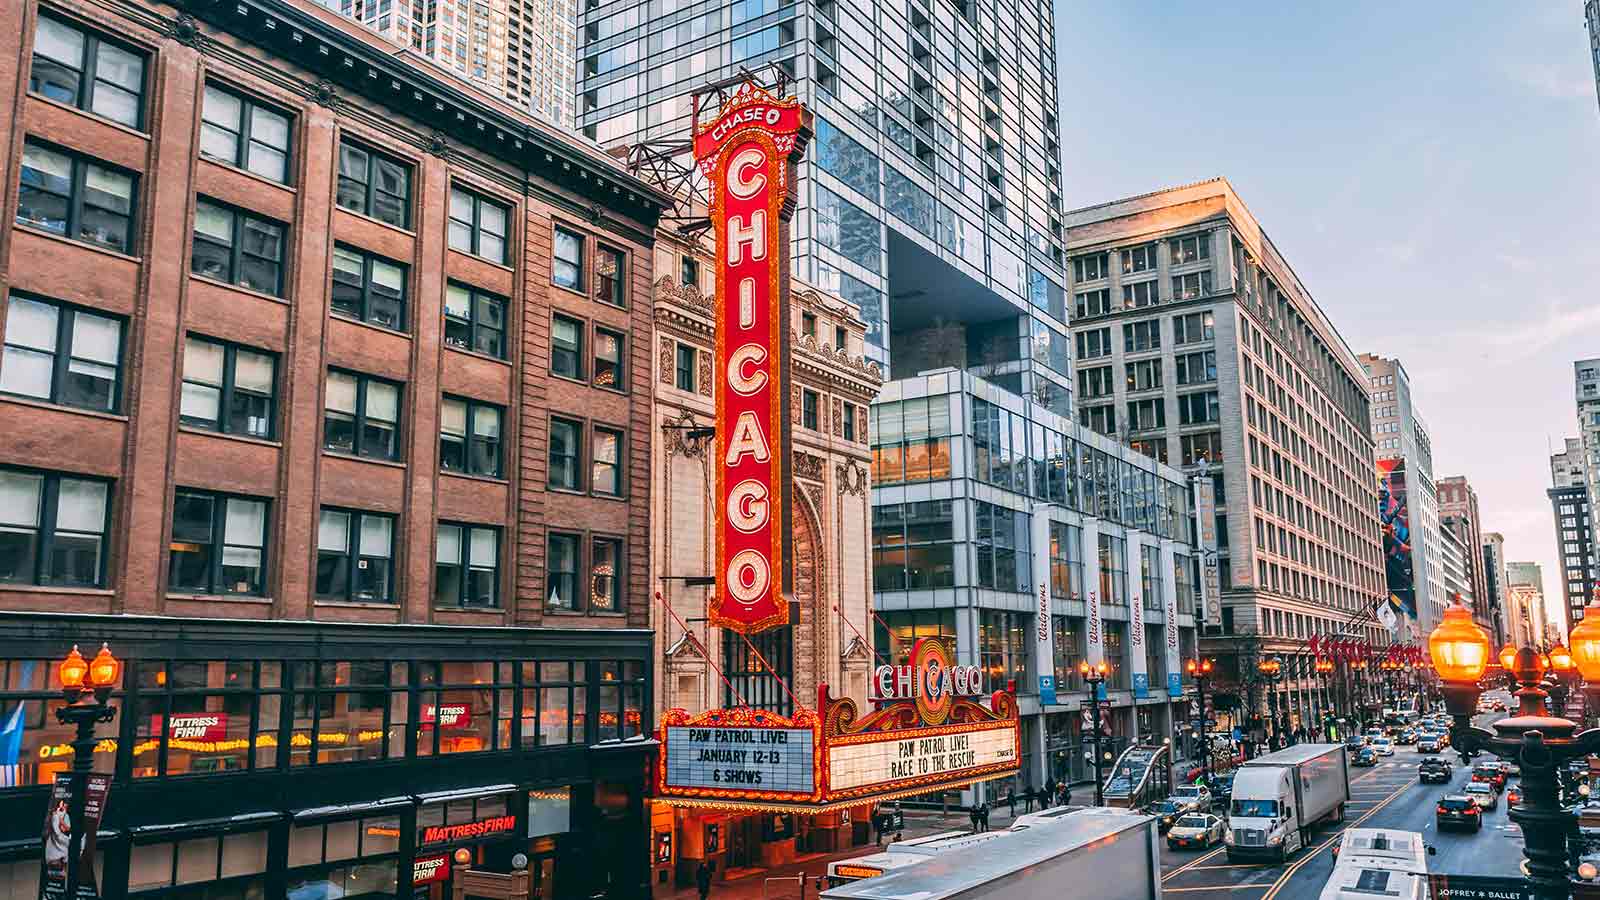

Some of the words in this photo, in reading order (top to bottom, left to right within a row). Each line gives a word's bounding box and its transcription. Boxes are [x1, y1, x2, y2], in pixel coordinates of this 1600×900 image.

[712, 107, 765, 141] CHASE
[726, 148, 771, 604] CHICAGO
[1204, 546, 1221, 624] JOFFREY
[1038, 583, 1049, 642] Walgreens
[1089, 591, 1101, 645] Walgreens
[1132, 597, 1143, 648] Walgreens
[1167, 602, 1178, 648] Walgreens
[876, 664, 983, 698] CHICAGO
[169, 717, 218, 729] ATTRESS
[427, 706, 465, 716] MTTRESS
[174, 726, 206, 738] FIRM
[689, 729, 711, 742] PAW
[715, 730, 756, 743] PATROL
[760, 731, 788, 744] LIVE!
[697, 750, 747, 763] JANUARY
[753, 751, 780, 764] 12-13
[899, 741, 915, 758] PAW
[919, 737, 946, 756] PATROL
[950, 735, 969, 752] LIVE!
[713, 769, 721, 782] 6
[724, 769, 762, 784] SHOWS
[891, 760, 914, 778] RACE
[918, 757, 928, 774] TO
[932, 755, 945, 771] THE
[949, 750, 976, 769] RESCUE
[413, 868, 436, 883] FIRM
[1439, 888, 1476, 897] JOFFREY
[1488, 891, 1521, 900] BALLET
